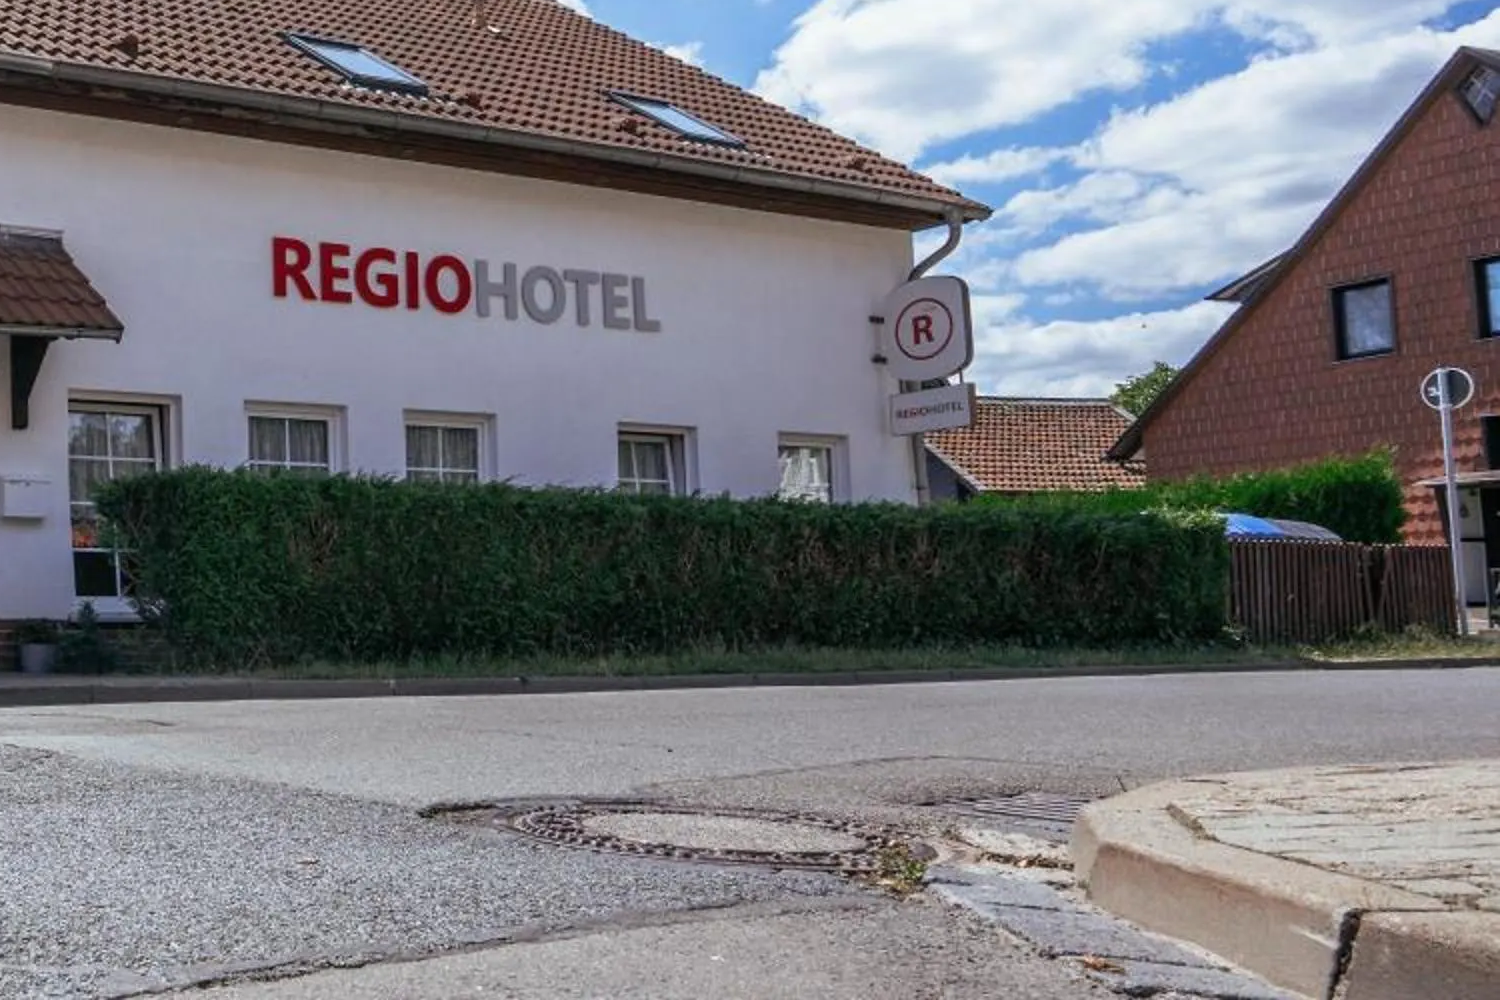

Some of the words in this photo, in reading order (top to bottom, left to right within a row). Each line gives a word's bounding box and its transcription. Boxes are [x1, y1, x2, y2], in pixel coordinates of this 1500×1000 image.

[271, 236, 661, 333] REGIOHOTEL
[911, 314, 935, 345] R
[896, 402, 965, 419] REGIOHOTEL
